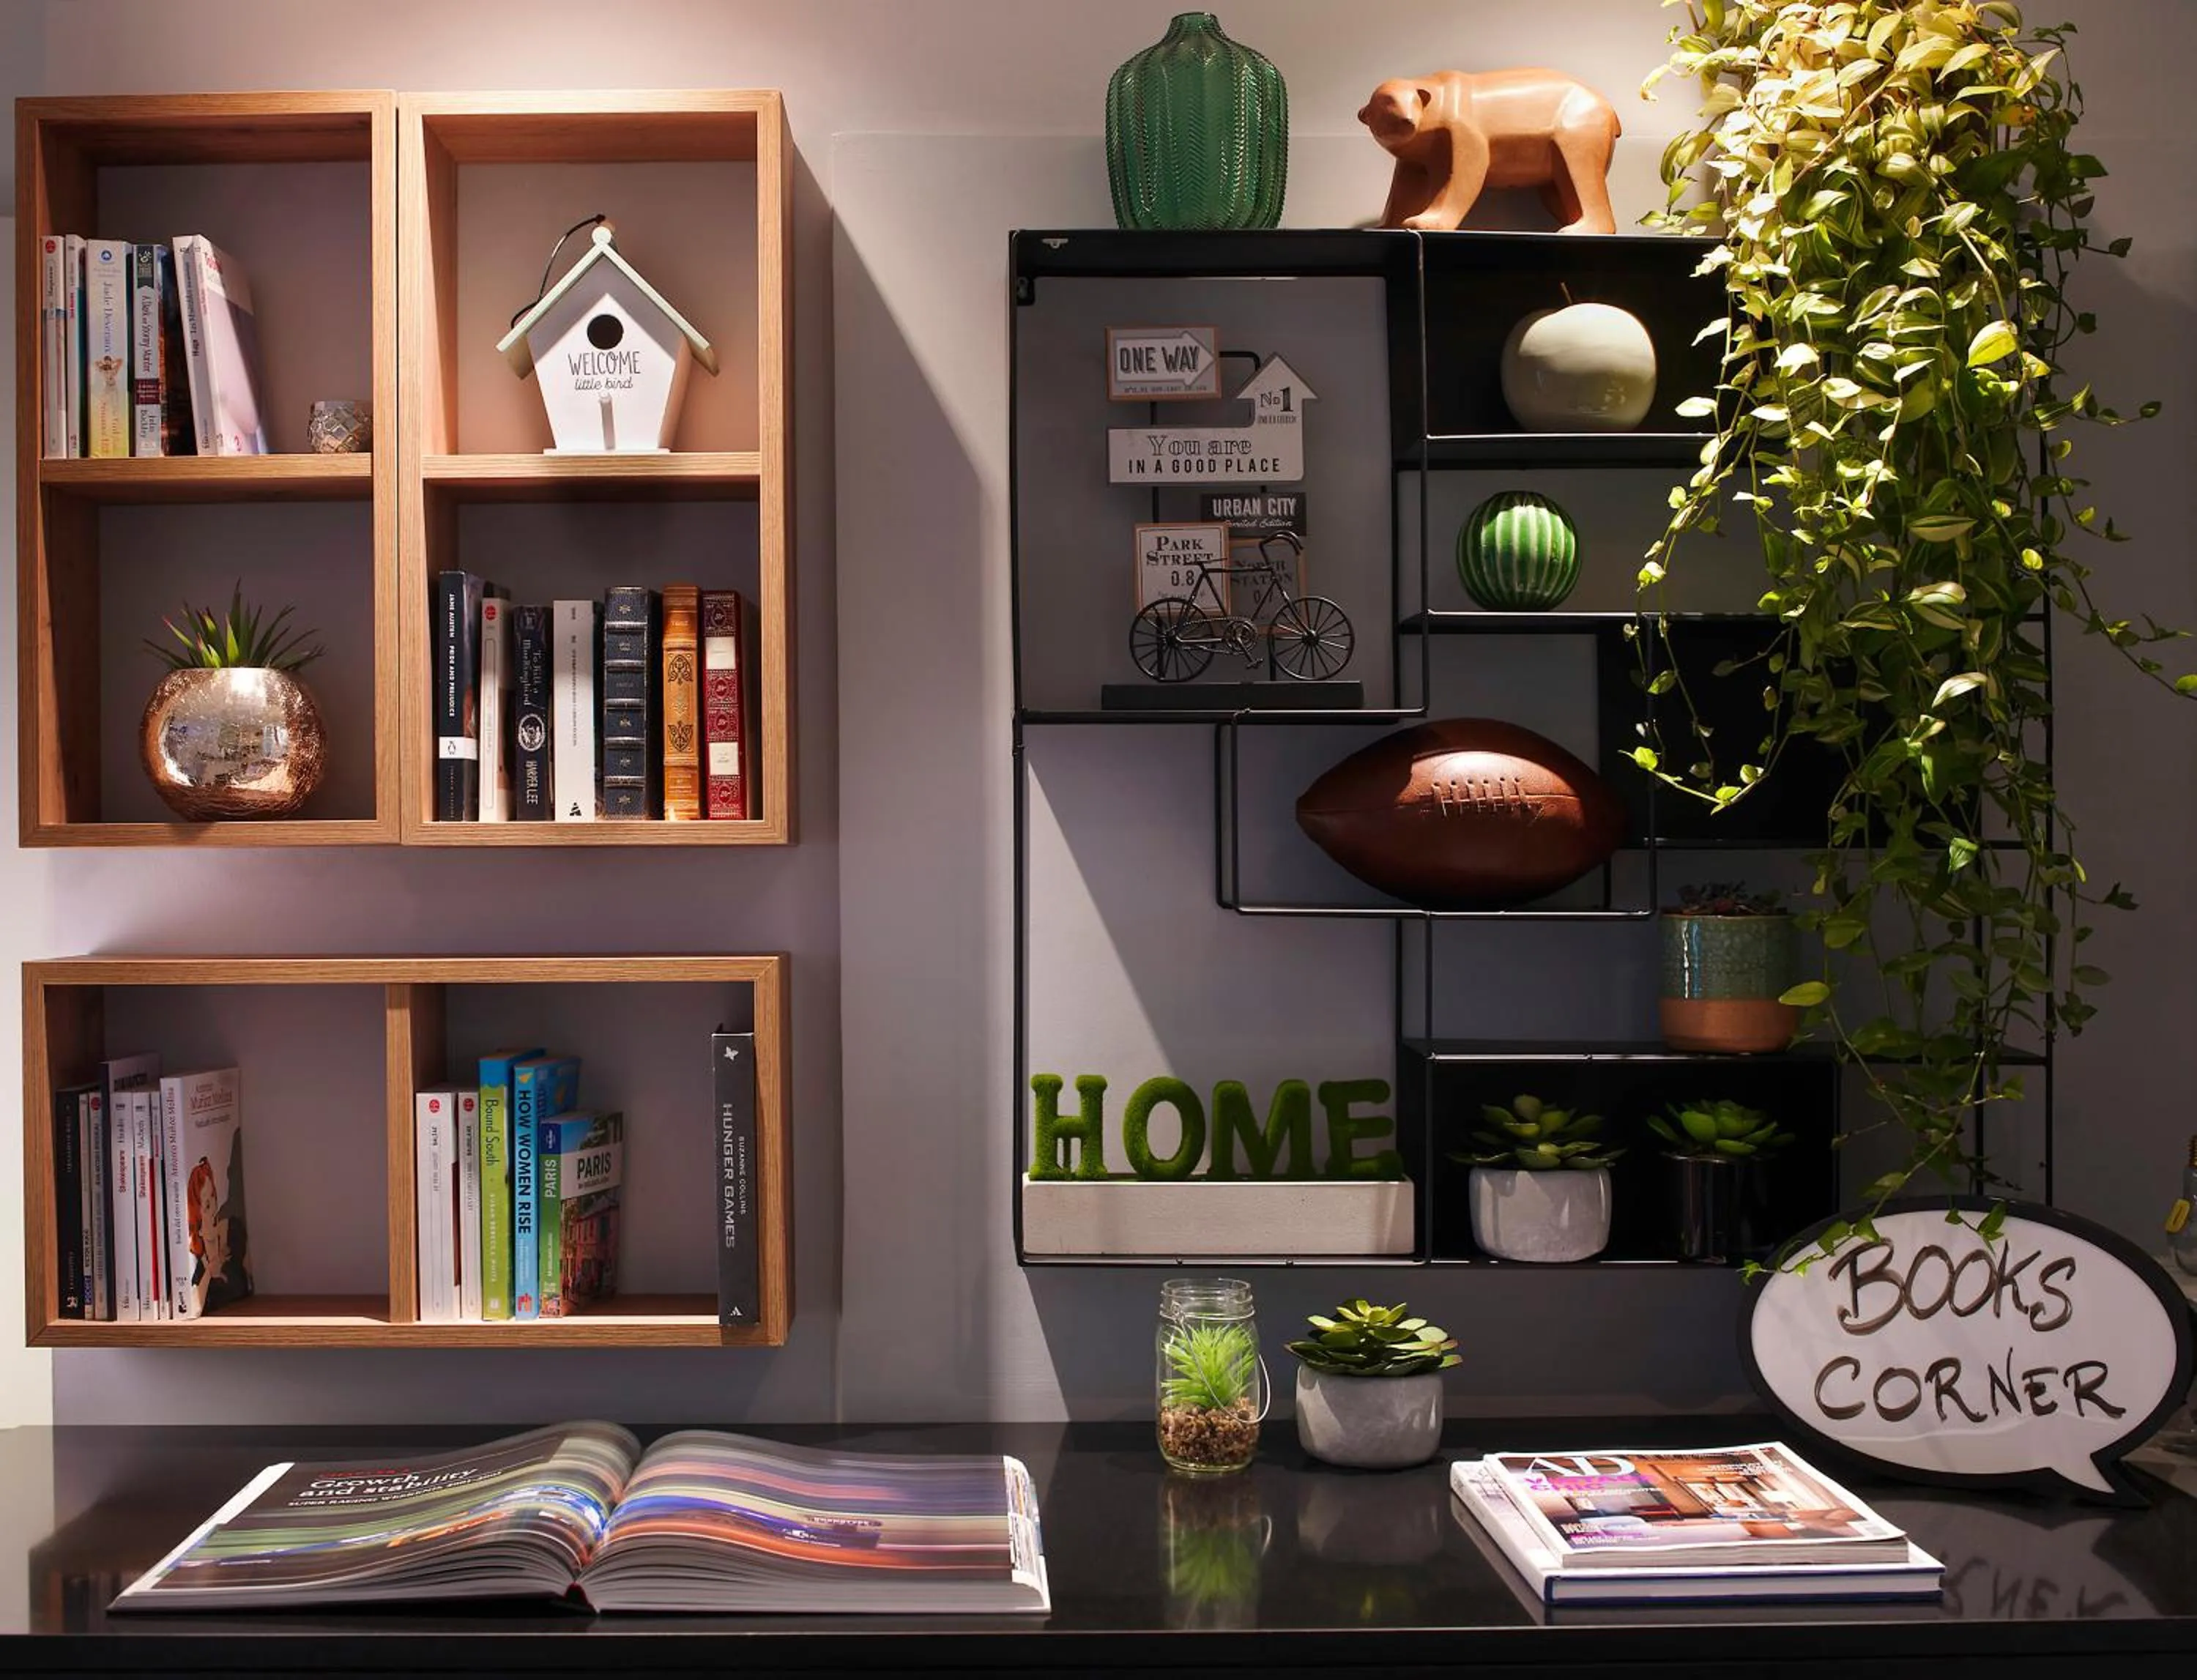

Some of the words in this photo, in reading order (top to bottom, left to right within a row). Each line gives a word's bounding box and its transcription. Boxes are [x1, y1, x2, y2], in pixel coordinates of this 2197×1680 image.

[140, 324, 152, 348] Stormy
[142, 349, 152, 373] Murder
[568, 351, 642, 376] WELCOME
[1120, 346, 1157, 374] ONE
[1161, 345, 1200, 373] WAY
[574, 377, 602, 390] little
[605, 376, 633, 389] bird
[1147, 434, 1200, 456] You
[1208, 439, 1252, 455] are
[1129, 458, 1145, 474] IN
[1154, 459, 1163, 473] A
[1172, 458, 1216, 473] GOOD
[1225, 458, 1280, 473] PLACE
[1212, 497, 1262, 517] URBAN
[1268, 497, 1297, 517] CITY
[1171, 570, 1195, 587] 0.8
[525, 760, 538, 789] HARPER
[526, 789, 538, 804] LEE
[485, 1099, 498, 1133] Bound
[518, 1090, 531, 1129] HOW
[1029, 1073, 1402, 1181] HOME
[487, 1137, 500, 1167] South
[721, 1104, 734, 1180] HUNGER
[737, 1135, 746, 1177] SUZANNE
[518, 1134, 531, 1197] WOMEN
[544, 1159, 557, 1198] PARIS
[577, 1151, 611, 1180] PARIS
[739, 1178, 747, 1215] COLLINS
[518, 1201, 531, 1234] RISE
[723, 1185, 735, 1249] GAMES
[1828, 1235, 2077, 1336] BOOKS
[1814, 1347, 2127, 1422] CORNER
[310, 1473, 420, 1489] Growth
[1525, 1457, 1635, 1476] AD
[299, 1486, 355, 1497] and
[363, 1468, 477, 1494] stability
